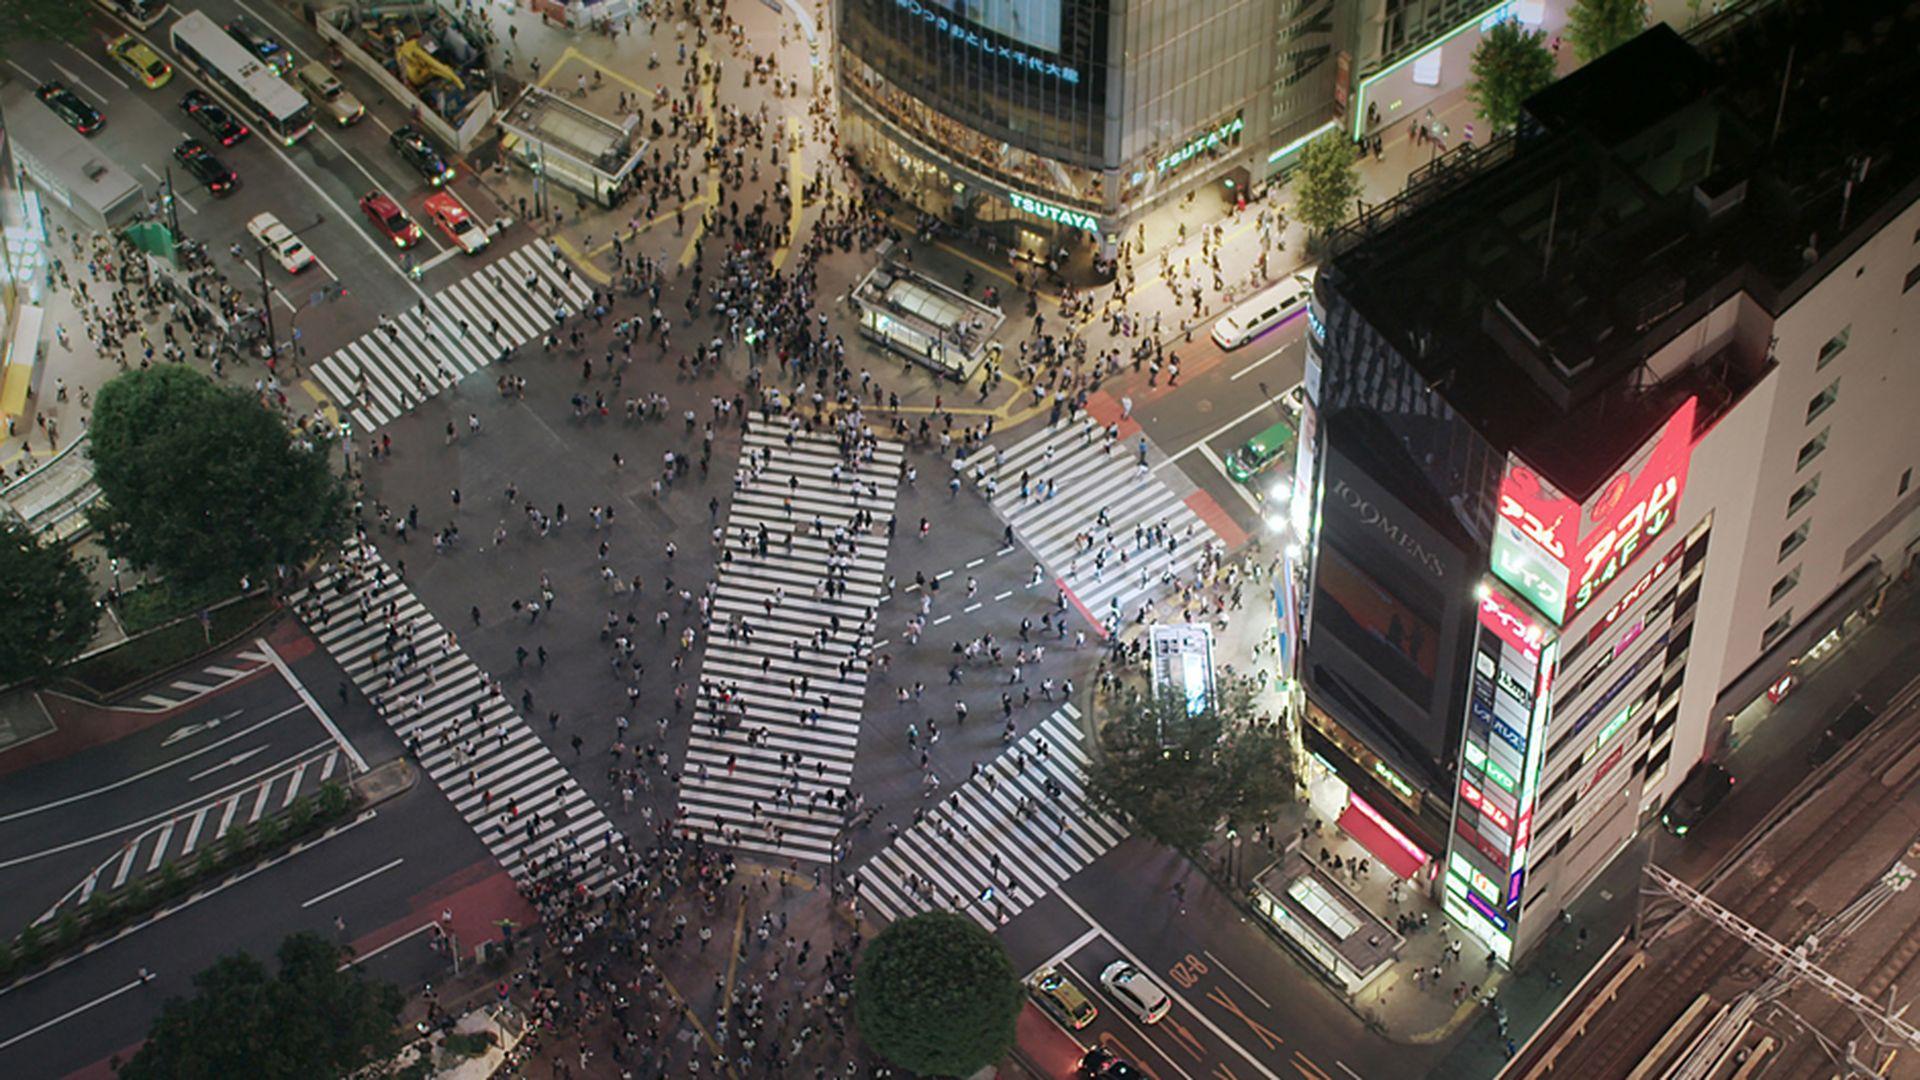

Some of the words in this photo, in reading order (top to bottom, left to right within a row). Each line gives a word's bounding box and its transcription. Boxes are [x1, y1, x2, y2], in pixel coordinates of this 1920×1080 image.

[1158, 118, 1244, 173] TSUTAYA
[1009, 192, 1099, 232] TSUTAYA
[1500, 494, 1565, 559] アコム
[1581, 475, 1678, 585] アコム
[1501, 548, 1559, 604] レイク
[1466, 785, 1508, 829] アコム
